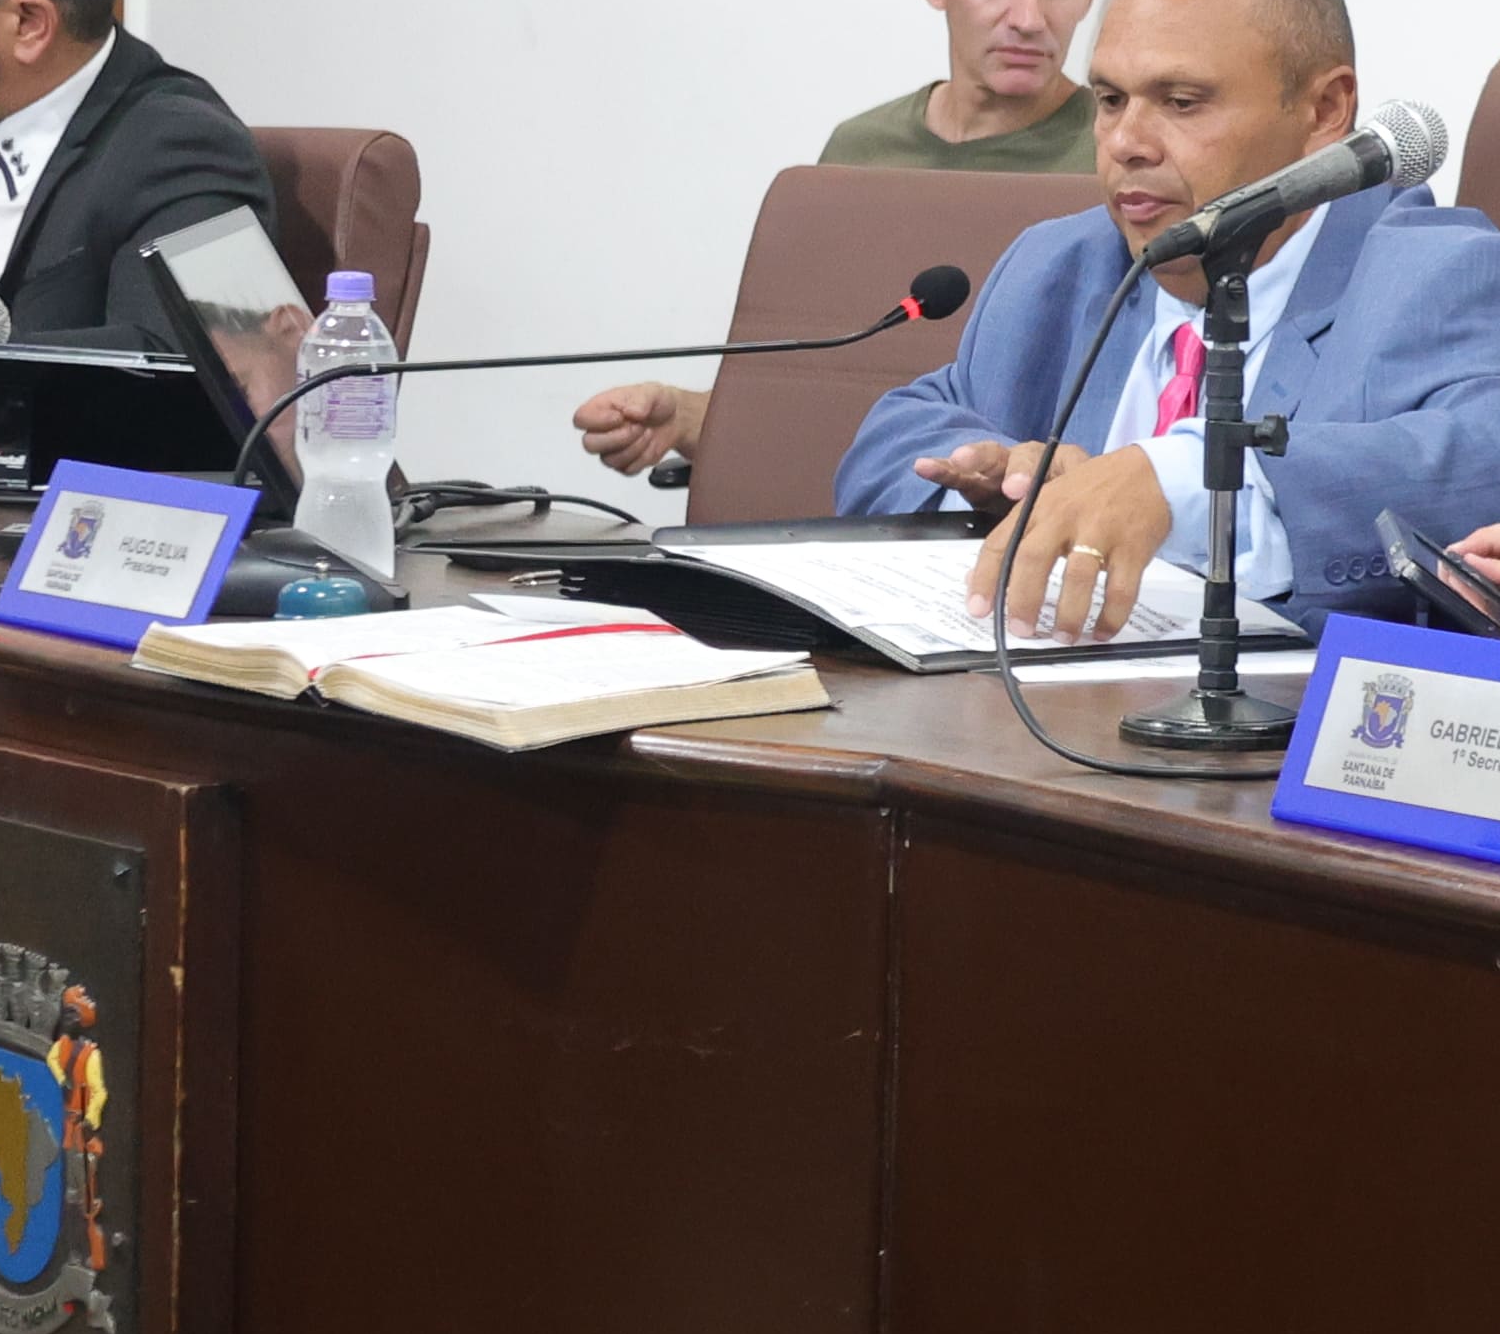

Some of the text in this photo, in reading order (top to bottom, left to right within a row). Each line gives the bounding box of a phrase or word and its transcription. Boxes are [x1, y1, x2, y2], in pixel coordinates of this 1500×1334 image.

[119, 536, 189, 562] HUGO SILVA
[1342, 760, 1396, 779] SANTANA DE
